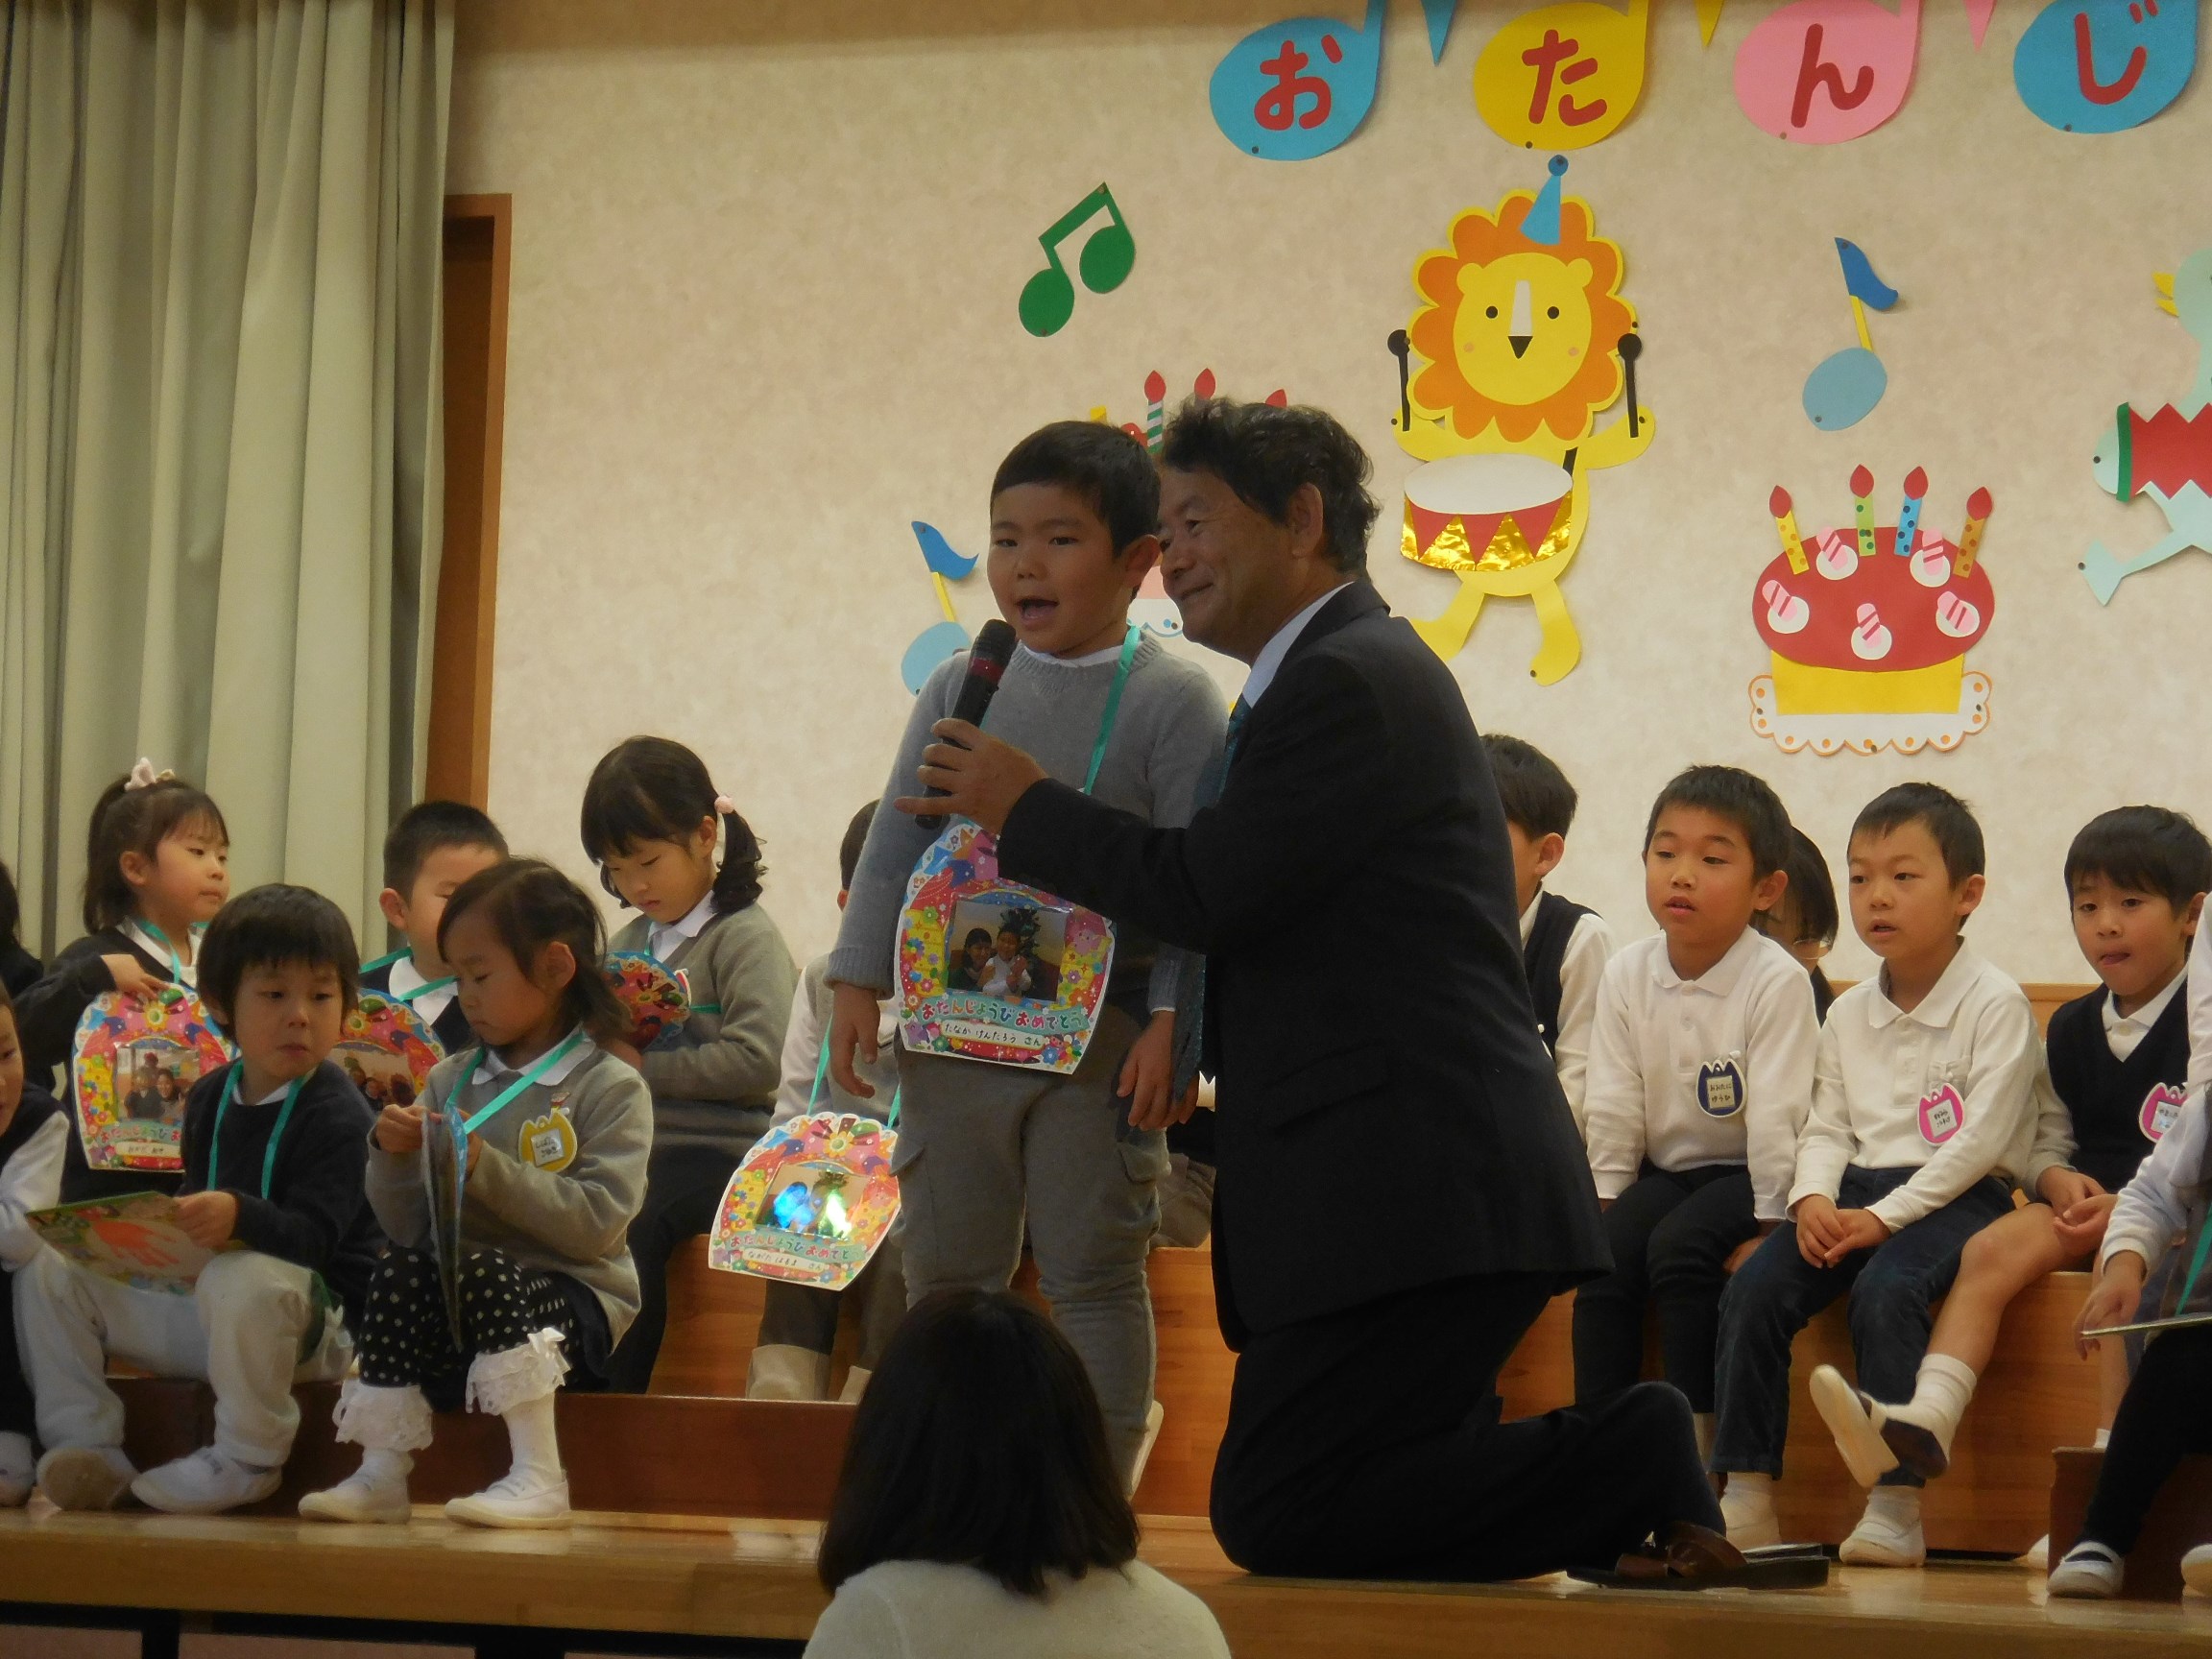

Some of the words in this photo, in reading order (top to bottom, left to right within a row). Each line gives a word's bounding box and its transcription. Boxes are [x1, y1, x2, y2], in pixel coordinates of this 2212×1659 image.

[1254, 37, 1343, 131] お
[1522, 30, 1607, 128] た
[1791, 23, 1875, 129] ん
[2077, 0, 2158, 105] じ
[922, 999, 1014, 1022] おたんじょうび
[1016, 1011, 1082, 1029] おめでとう
[731, 1235, 804, 1252] おたんじょうび
